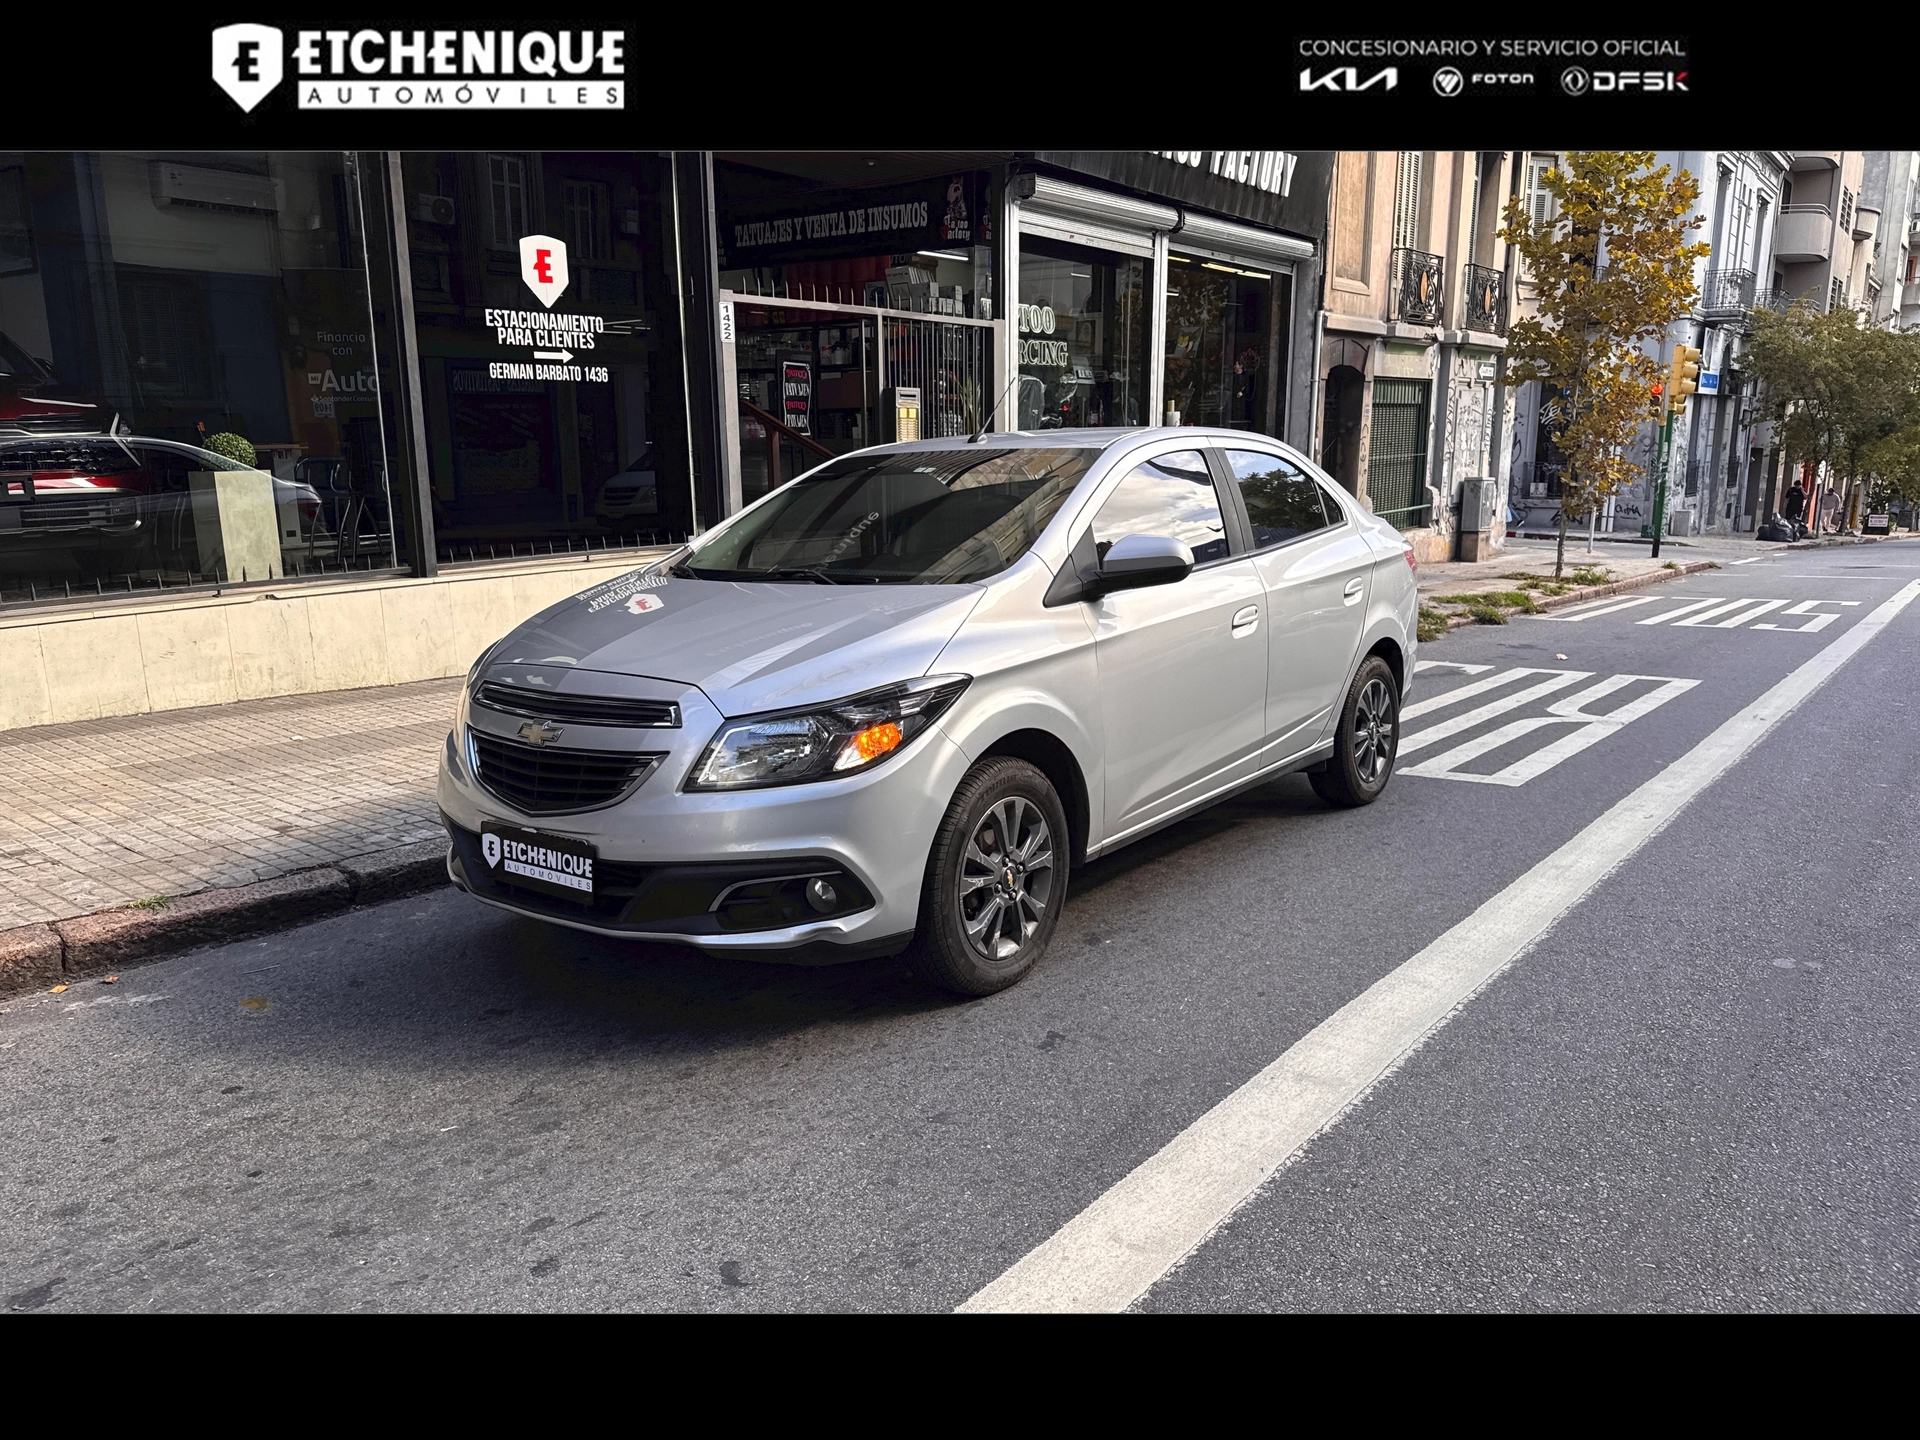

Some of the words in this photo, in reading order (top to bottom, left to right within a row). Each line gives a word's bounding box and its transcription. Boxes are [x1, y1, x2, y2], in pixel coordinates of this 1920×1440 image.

[1209, 151, 1298, 197] FACTORY
[735, 219, 792, 247] TATUAJES
[795, 217, 803, 241] Y
[804, 209, 847, 238] VENTA
[848, 208, 866, 234] DE
[867, 201, 928, 231] INSUMOS
[485, 308, 604, 333] ESTACIONAMIENTO
[723, 305, 731, 340] 1422
[317, 331, 366, 343] Financia
[497, 328, 534, 347] PARA
[536, 331, 595, 349] CLIENTES
[332, 346, 353, 356] con
[321, 369, 378, 392] Auto
[489, 363, 534, 380] GERMAN
[536, 364, 582, 382] BARBATO
[584, 367, 609, 383] 1436
[1395, 660, 1703, 788] BU
[503, 839, 593, 879] ETCHENIQUE
